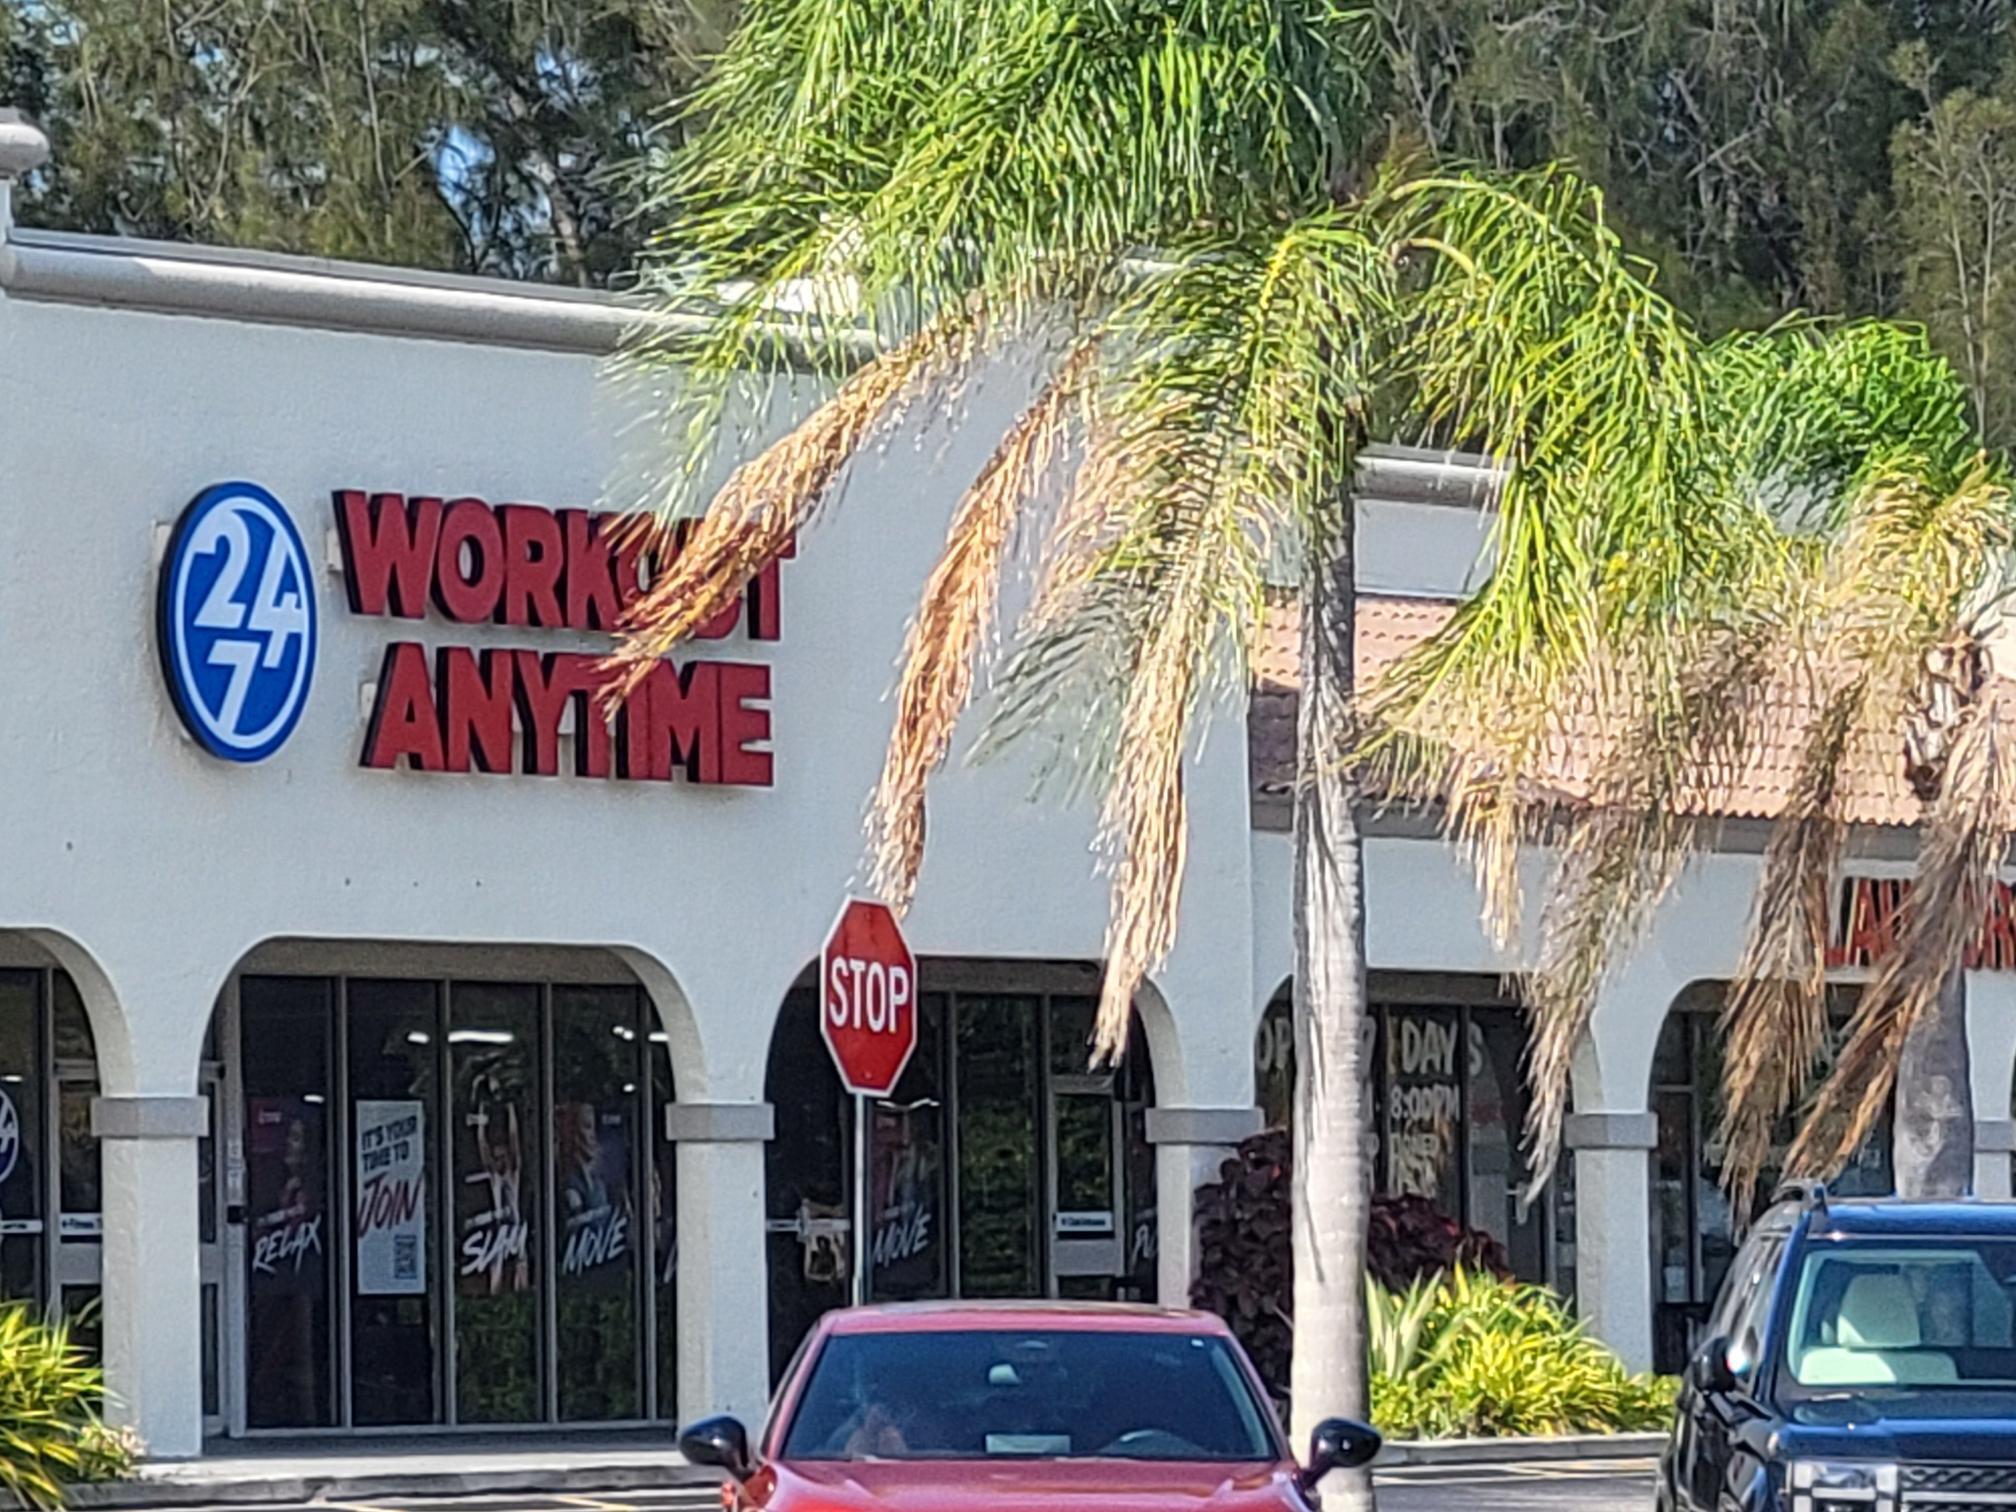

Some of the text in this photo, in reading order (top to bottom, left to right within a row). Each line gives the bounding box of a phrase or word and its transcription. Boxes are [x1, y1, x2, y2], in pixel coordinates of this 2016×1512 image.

[190, 506, 305, 668] 24
[332, 491, 796, 641] WORKOT
[206, 638, 262, 733] 7
[359, 642, 774, 786] ANYTIME
[830, 956, 909, 1034] STOP
[1402, 1018, 1484, 1077] DAYS
[393, 1140, 410, 1162] TO
[358, 1171, 424, 1239] JOIN
[873, 1204, 931, 1269] MOVE
[253, 1212, 321, 1274] RELAX
[562, 1206, 627, 1276] MOVE
